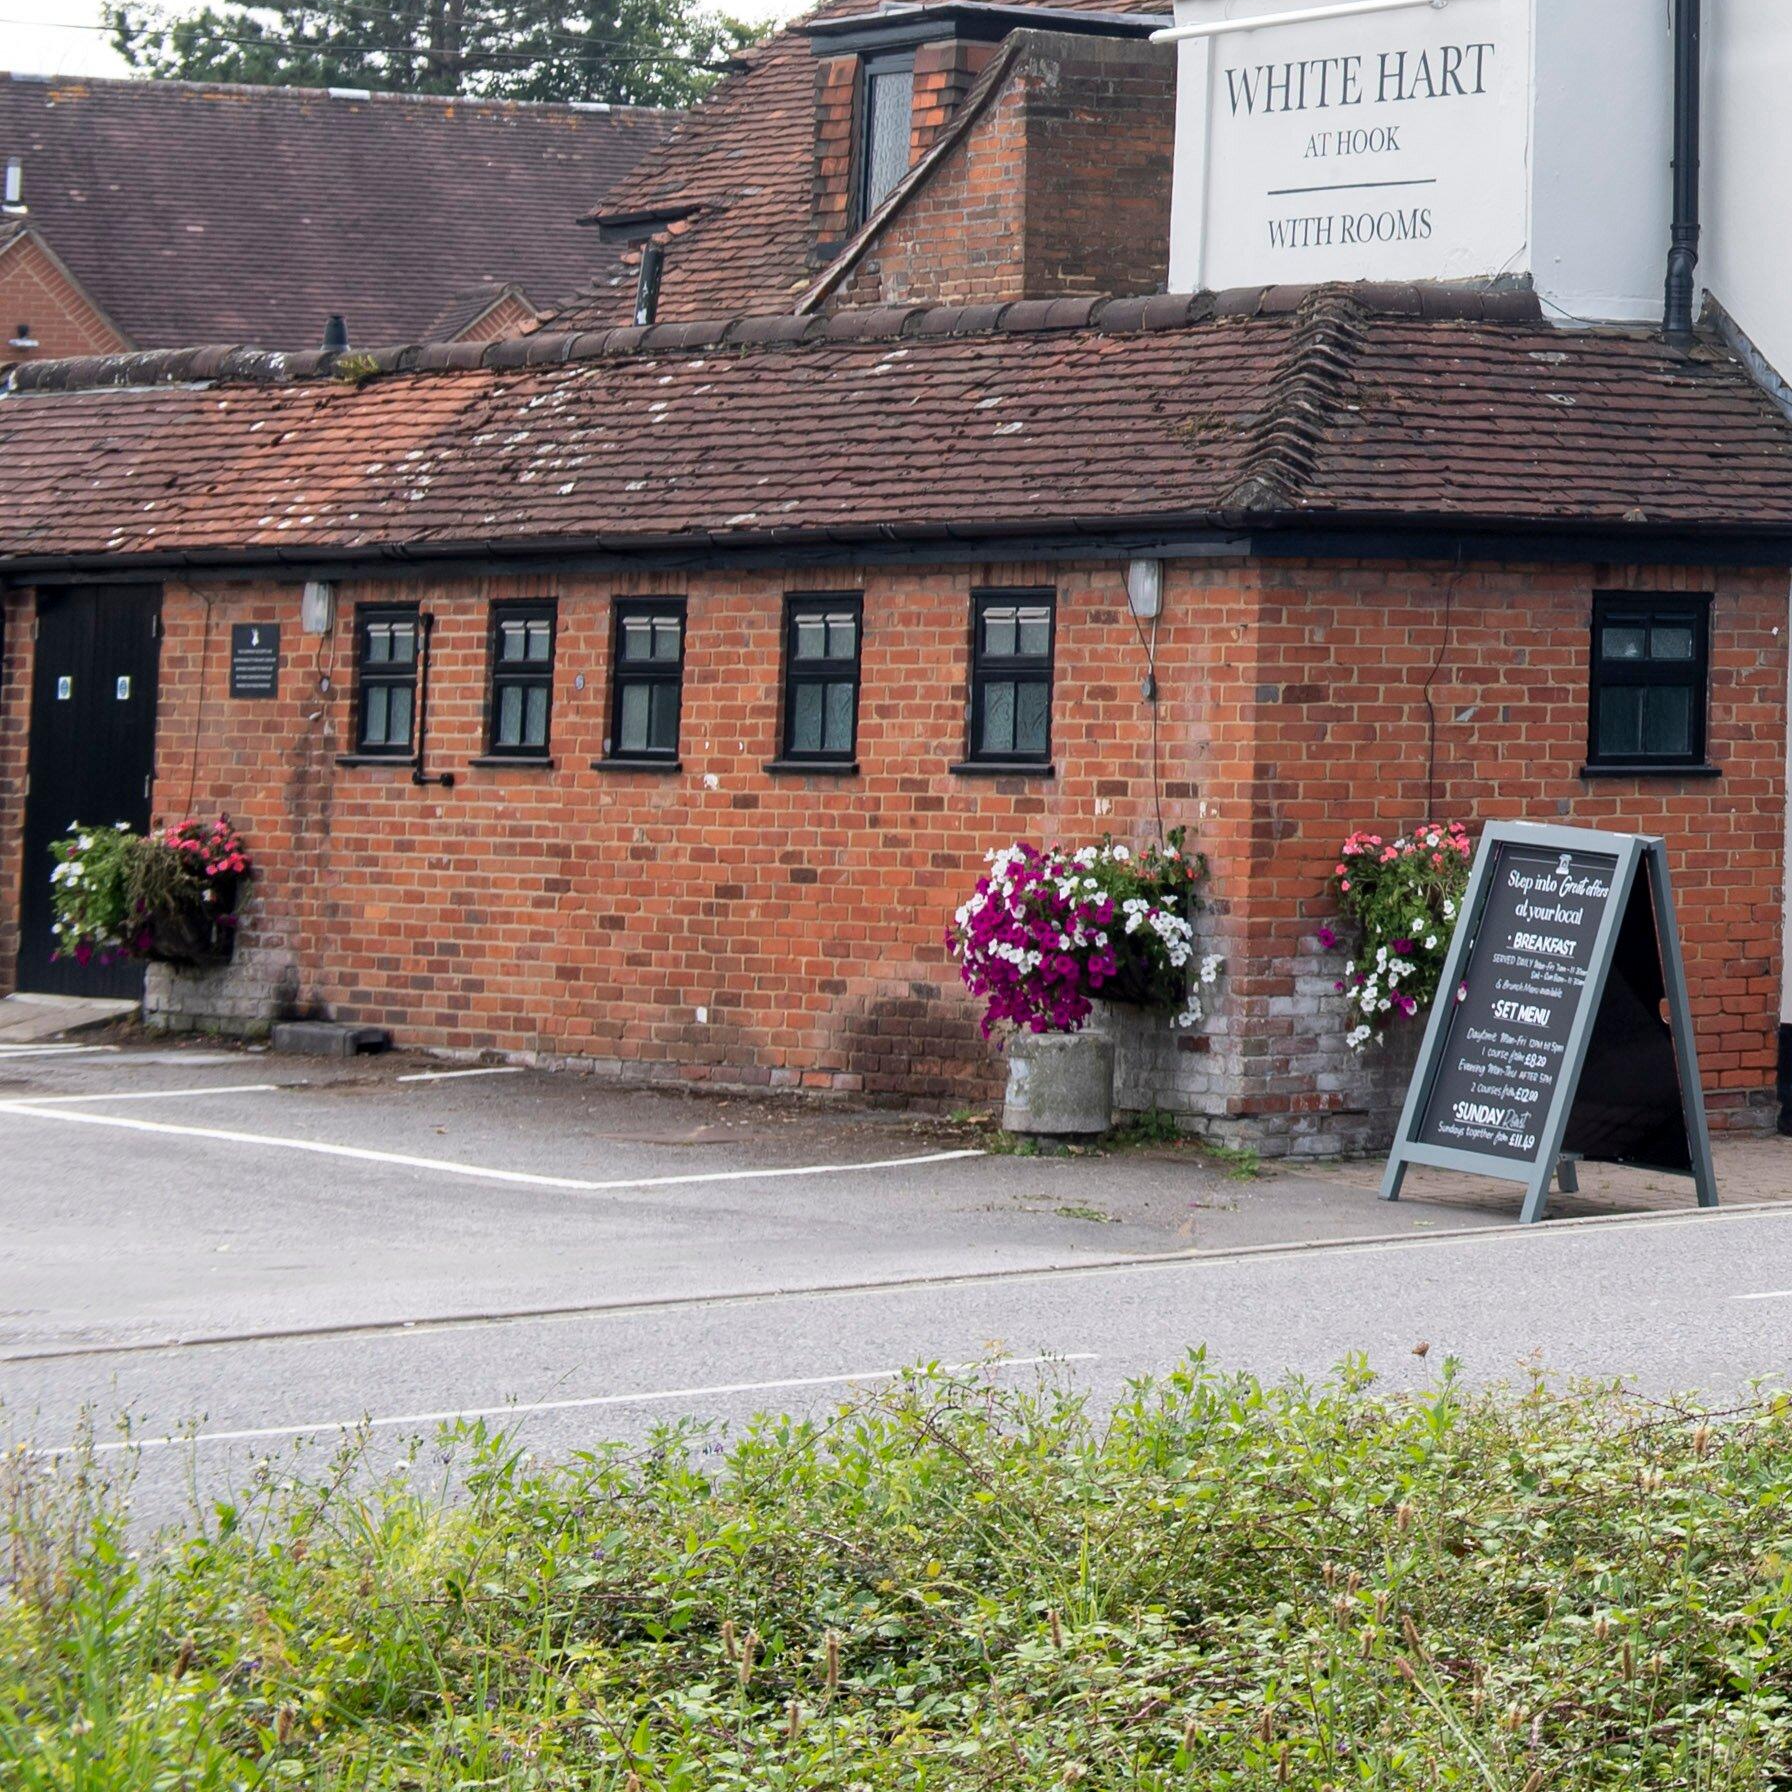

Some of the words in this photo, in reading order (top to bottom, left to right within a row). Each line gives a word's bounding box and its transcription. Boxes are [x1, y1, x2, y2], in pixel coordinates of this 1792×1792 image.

[1224, 55, 1363, 118] WHITE
[1374, 42, 1496, 104] HART
[1304, 131, 1332, 159] AT
[1336, 124, 1401, 156] HOOK
[1267, 215, 1335, 250] WITH
[1340, 208, 1433, 244] ROOMS
[1507, 869, 1533, 895] Step
[1535, 873, 1557, 892] into
[1559, 875, 1589, 897] Great
[1586, 879, 1609, 897] offers
[1515, 898, 1528, 917] at
[1527, 905, 1555, 922] your
[1555, 903, 1584, 925] local
[1513, 932, 1577, 956] BREAKFAST
[1492, 953, 1516, 965] SERVED
[1516, 956, 1534, 968] DAILY
[1495, 978, 1502, 989] &
[1502, 979, 1522, 992] Brunch
[1494, 999, 1519, 1020] SET
[1517, 1004, 1551, 1026] MENU
[1466, 1027, 1497, 1043] Daytime
[1487, 1048, 1509, 1060] course
[1458, 1058, 1485, 1077] Evening
[1519, 1070, 1540, 1083] AFTER
[1470, 1082, 1476, 1093] 2
[1456, 1101, 1505, 1126] SUNDAY
[1438, 1120, 1464, 1138] Sundays
[1465, 1125, 1494, 1140] together
[1508, 1133, 1536, 1151] £11.49
